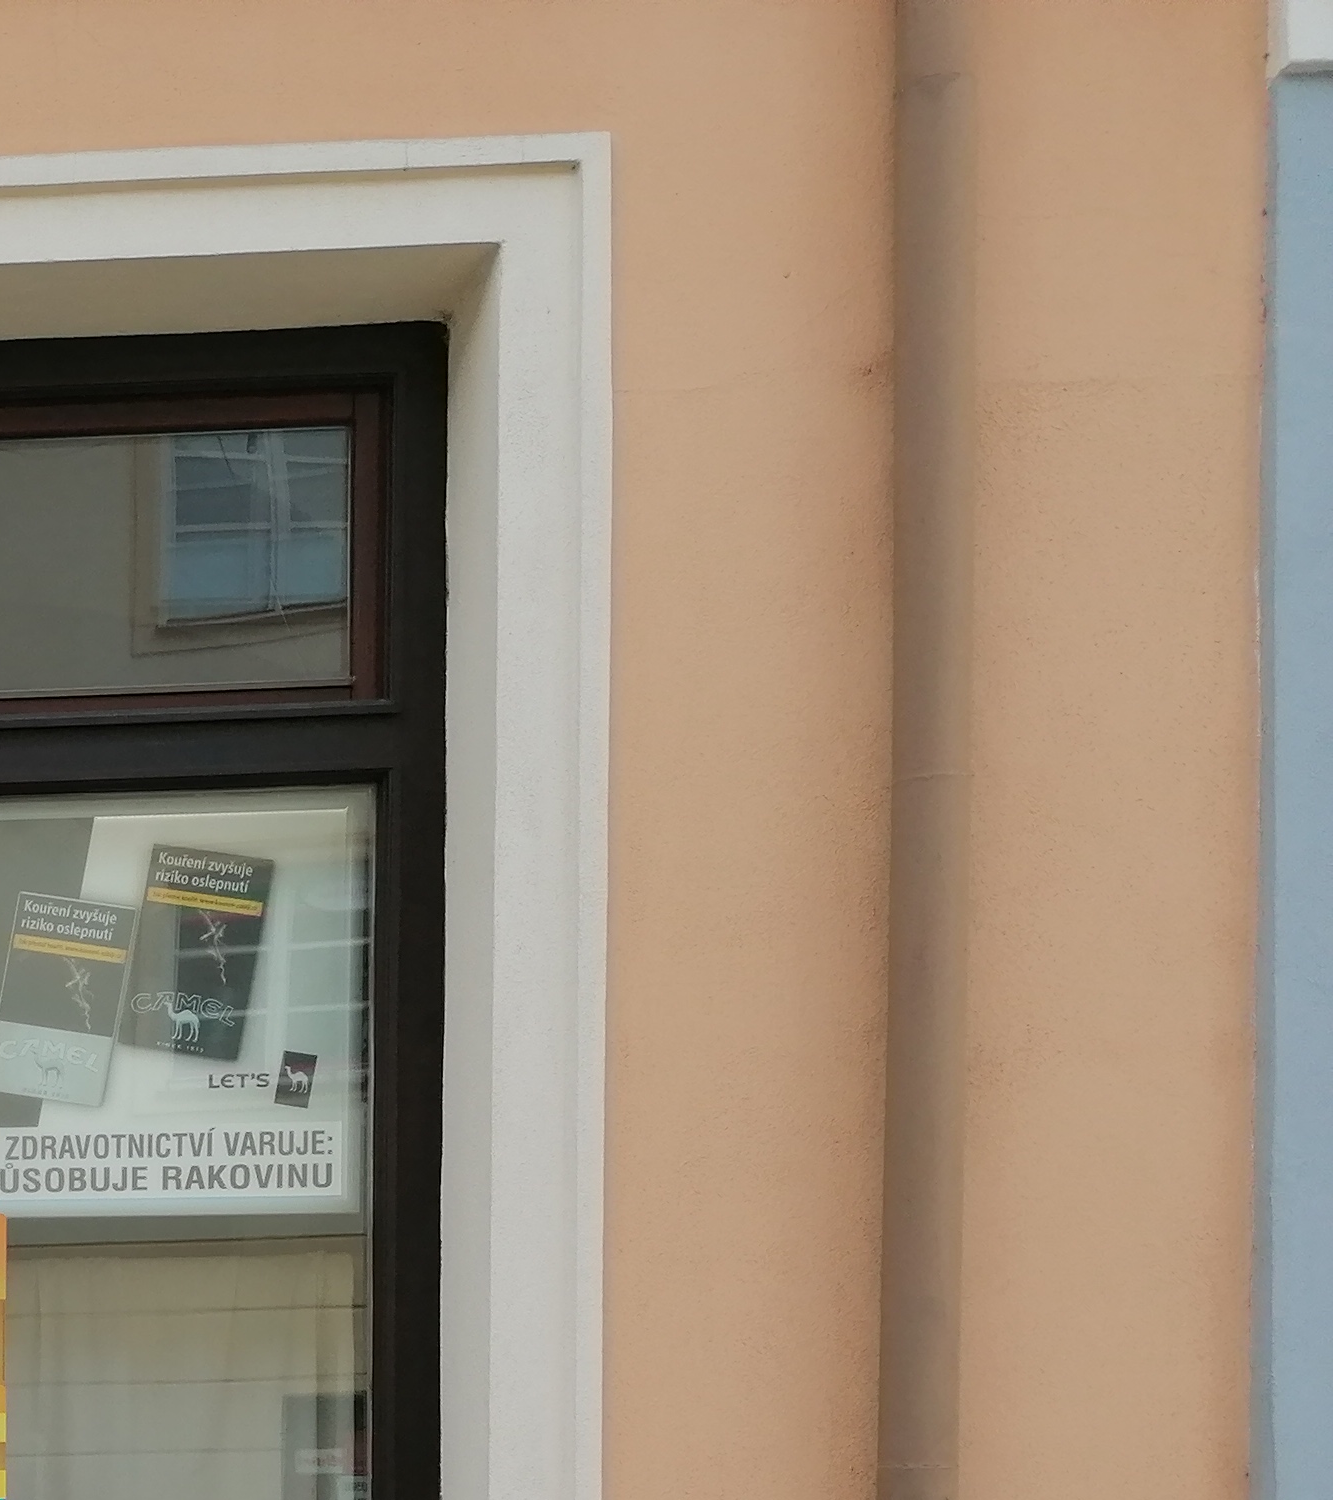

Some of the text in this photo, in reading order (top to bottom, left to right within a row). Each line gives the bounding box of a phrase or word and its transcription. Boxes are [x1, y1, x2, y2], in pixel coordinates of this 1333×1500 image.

[157, 850, 254, 879] Kouření zvyšuje
[154, 868, 250, 895] riziko oslepnutí
[23, 899, 118, 926] Kouření zvyšuje
[19, 915, 113, 942] riziko oslepnutí
[130, 990, 236, 1028] CAMEL
[208, 1072, 271, 1090] LET'S
[4, 1127, 216, 1161] ZDRAVOTNICTVÍ
[223, 1130, 335, 1157] VARUJE:
[161, 1162, 335, 1190] RAKOVINU
